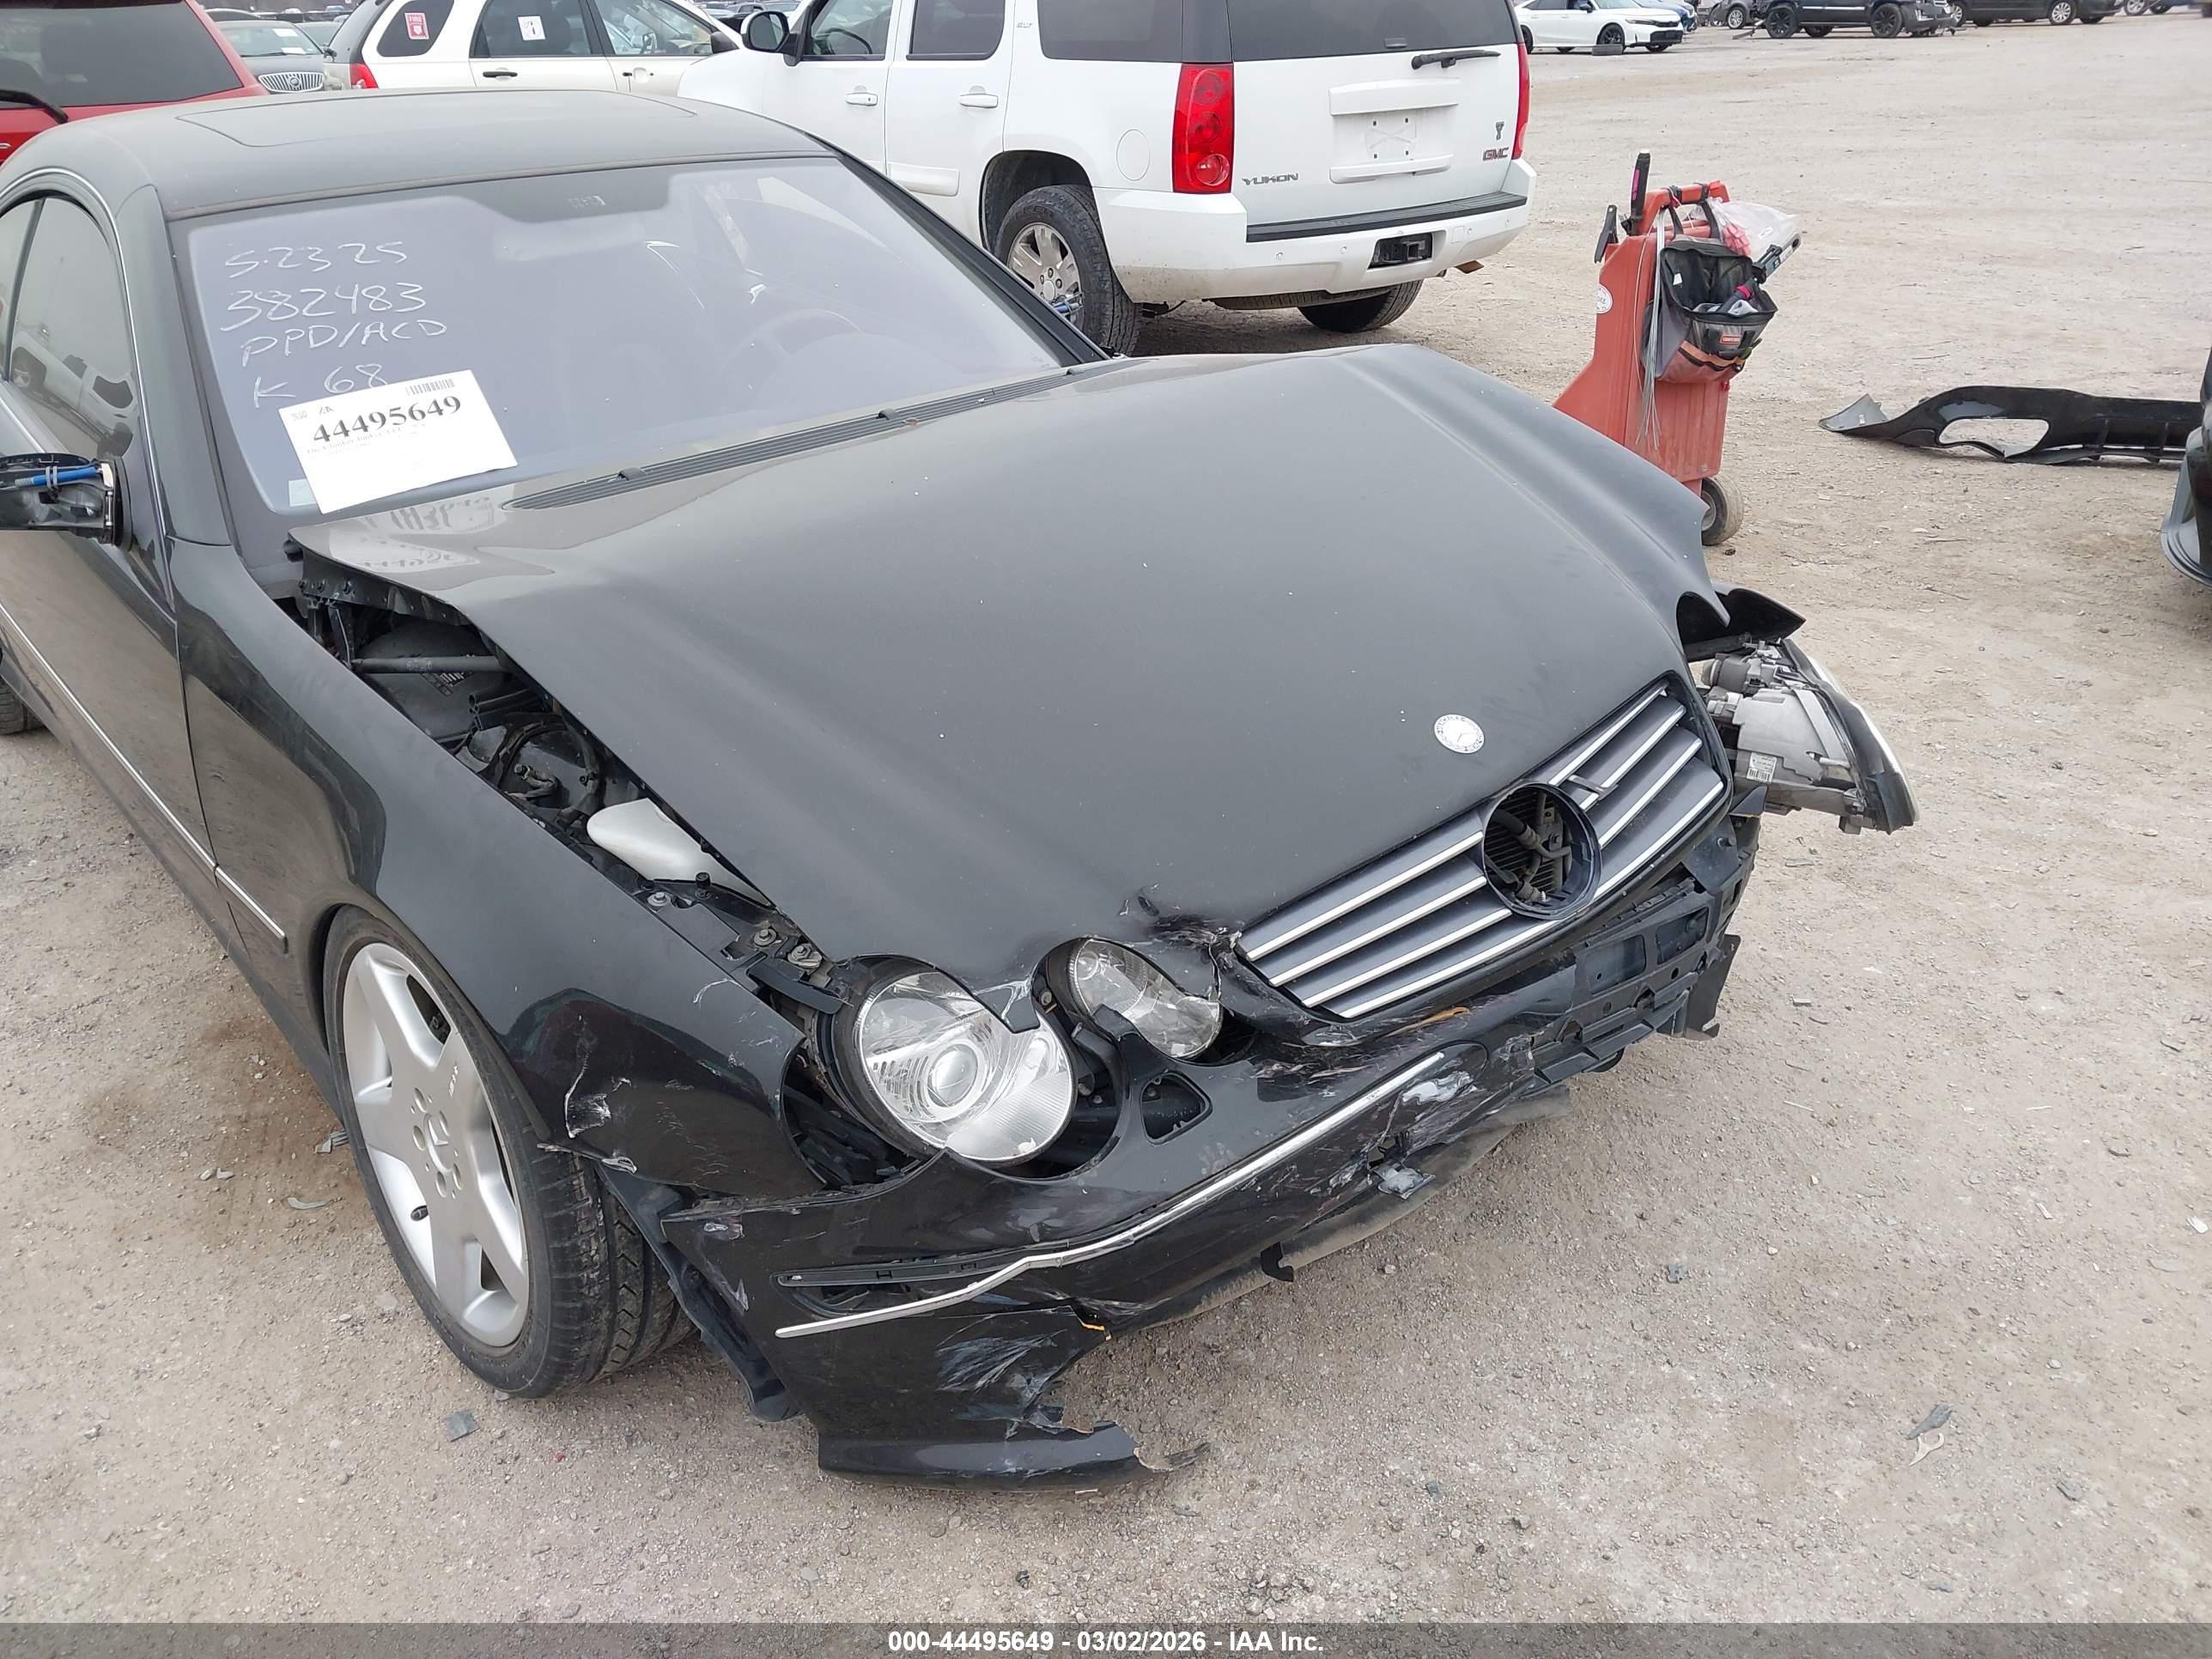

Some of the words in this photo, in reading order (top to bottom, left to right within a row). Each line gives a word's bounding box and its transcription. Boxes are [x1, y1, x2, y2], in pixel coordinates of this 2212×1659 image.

[1483, 147, 1509, 161] GMC
[1242, 173, 1298, 185] YUKON
[220, 283, 426, 331] 382483
[324, 363, 387, 394] 68
[313, 395, 461, 443] 44495649
